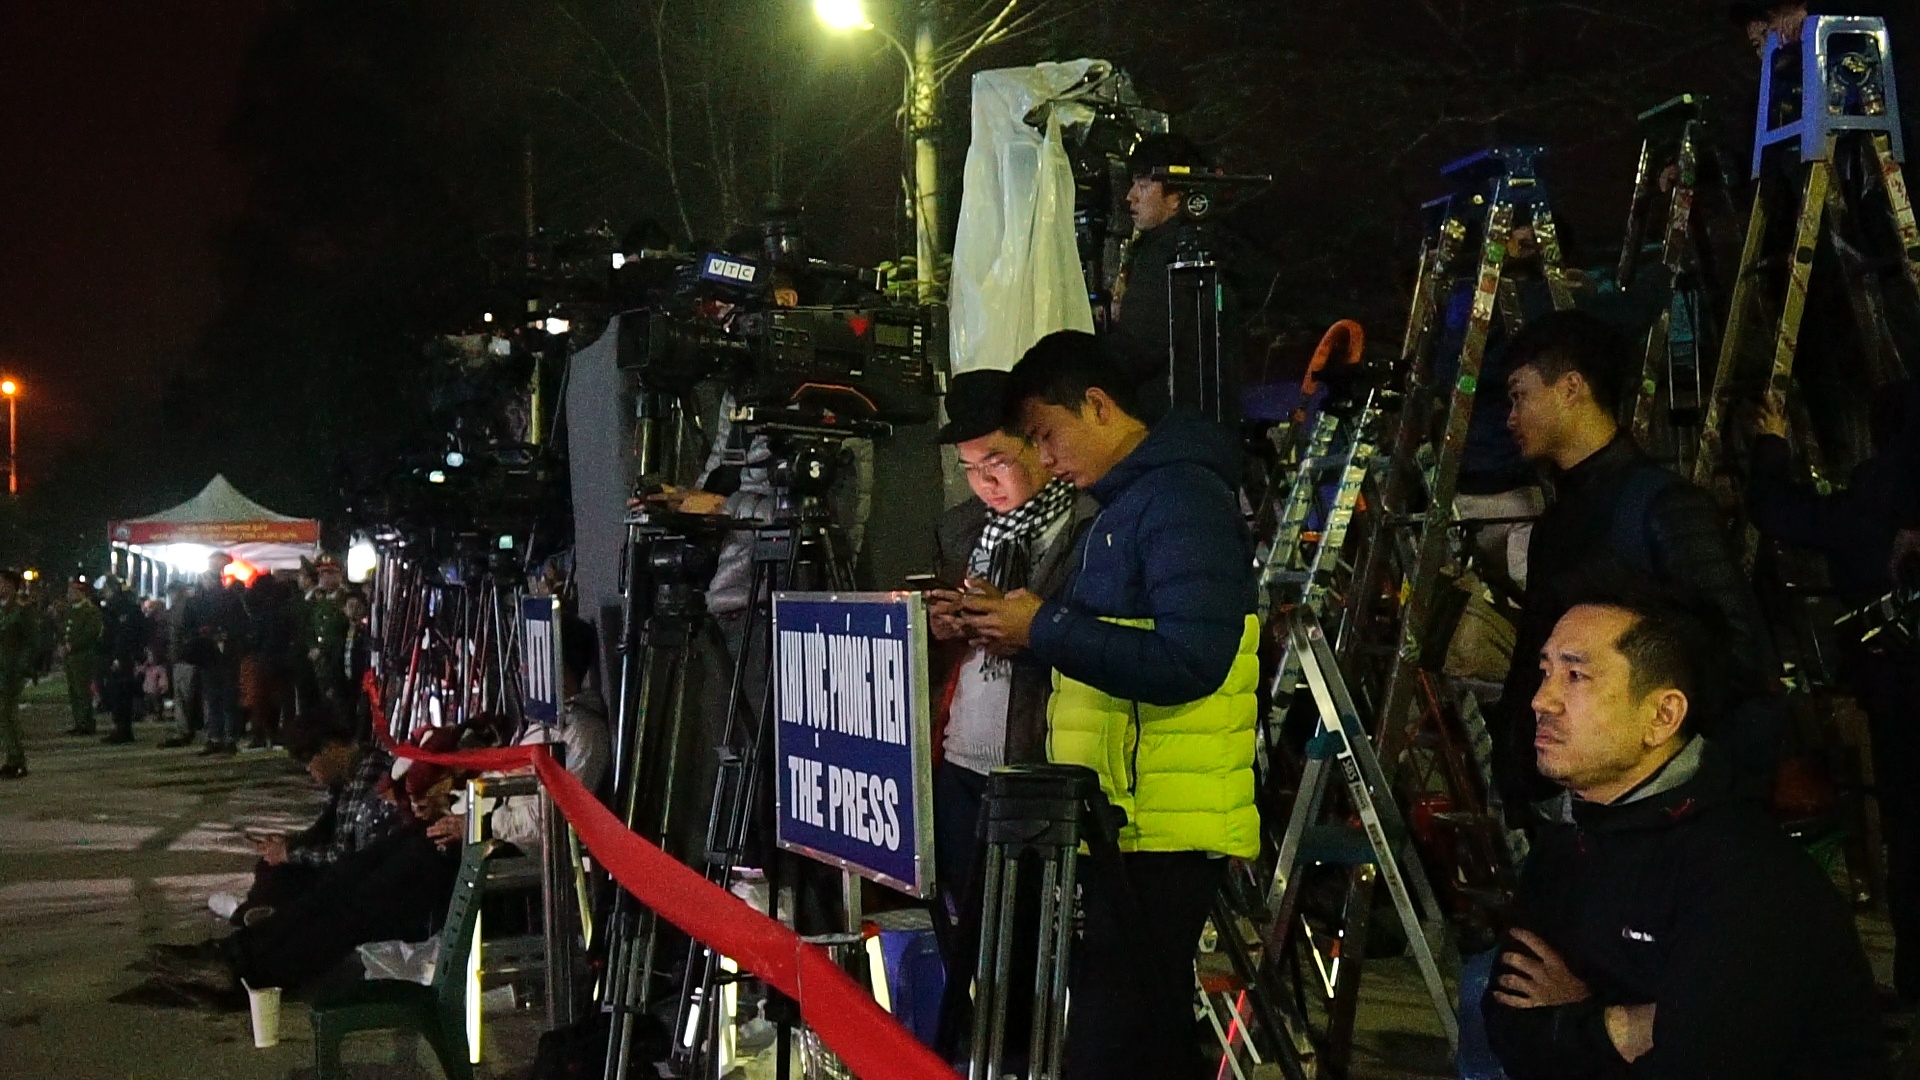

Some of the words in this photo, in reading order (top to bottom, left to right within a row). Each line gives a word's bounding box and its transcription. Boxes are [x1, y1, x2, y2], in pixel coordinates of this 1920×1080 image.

[711, 260, 753, 279] VTC
[781, 630, 803, 725] KHU
[872, 614, 907, 746] VIÊN
[788, 755, 824, 828] THE
[828, 765, 900, 851] PRESS
